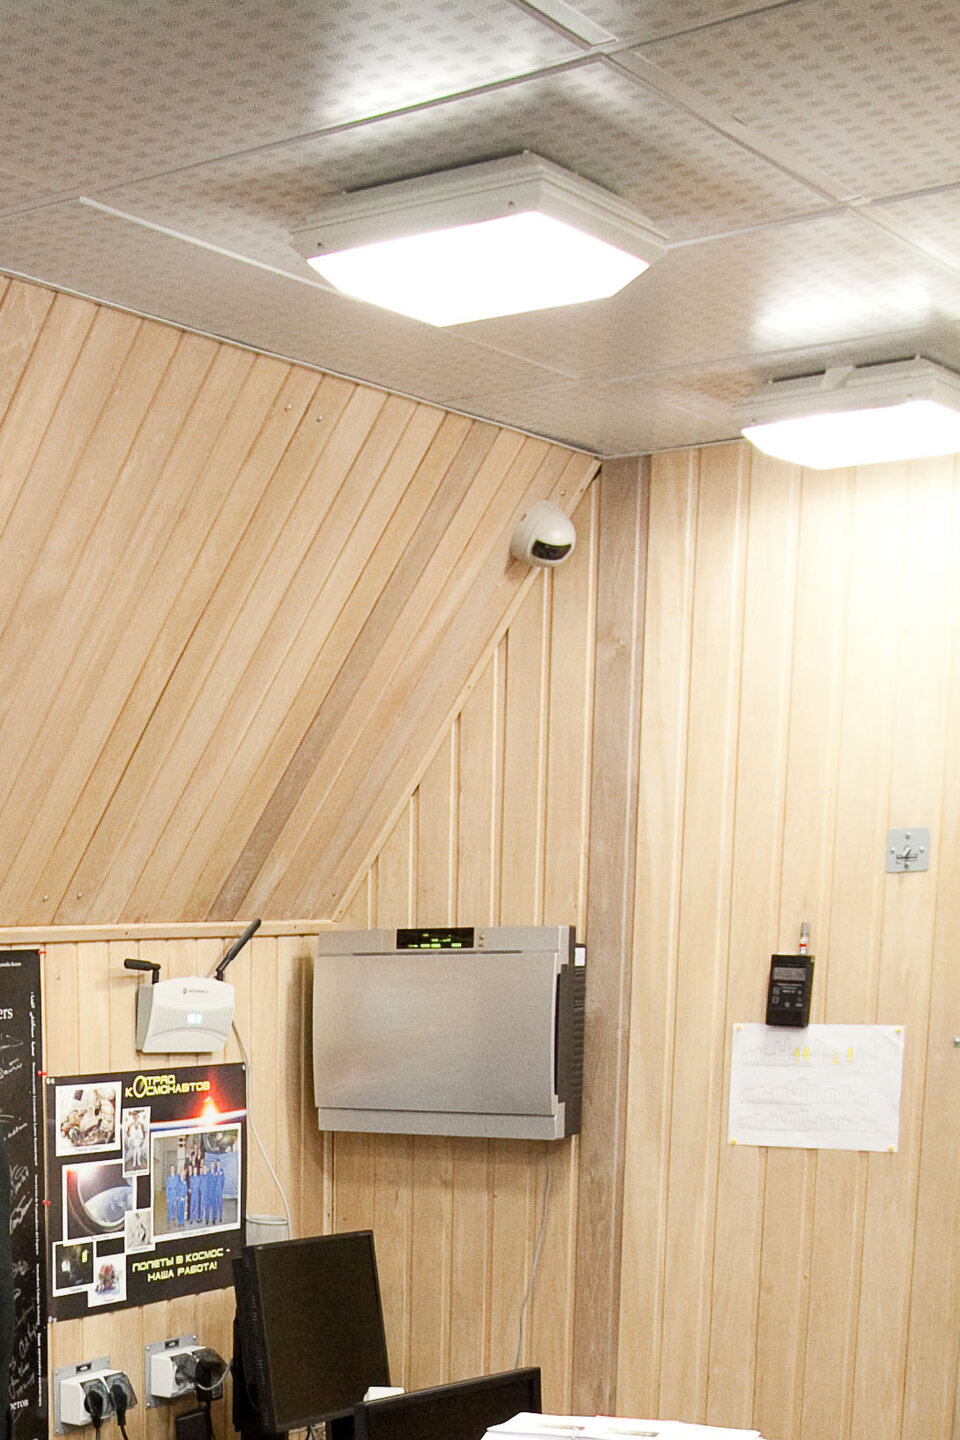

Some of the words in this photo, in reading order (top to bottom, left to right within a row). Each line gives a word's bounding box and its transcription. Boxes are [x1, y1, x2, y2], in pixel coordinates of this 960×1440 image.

[124, 1078, 211, 1099] КОСМОНАВТОВ
[132, 1256, 174, 1272] ПОЛЕТЫ
[175, 1255, 183, 1265] В
[185, 1249, 225, 1265] КОСМОС
[147, 1269, 176, 1282] НАША
[177, 1262, 218, 1278] РАБОТА!
